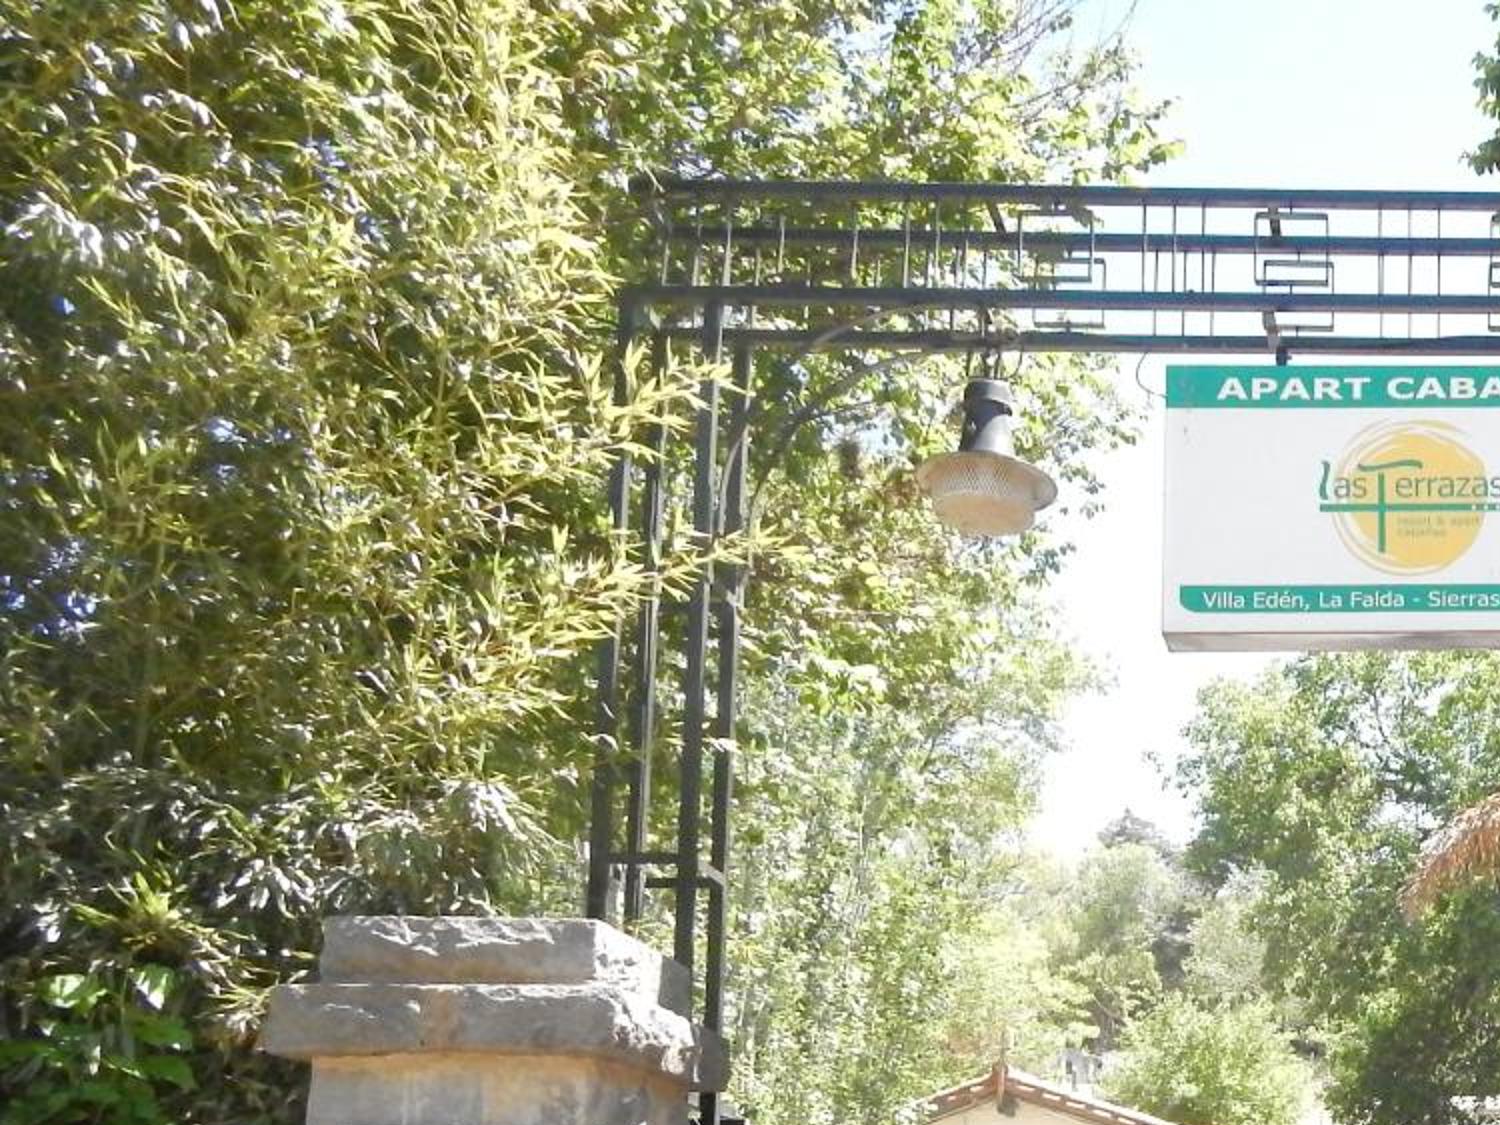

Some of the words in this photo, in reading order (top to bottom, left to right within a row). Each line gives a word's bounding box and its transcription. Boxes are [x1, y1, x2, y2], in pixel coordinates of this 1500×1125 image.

[1217, 376, 1371, 402] APART
[1318, 460, 1368, 501] las
[1203, 590, 1246, 609] Villa
[1253, 589, 1310, 612] Edén,
[1319, 590, 1344, 608] La
[1351, 589, 1405, 608] Falda
